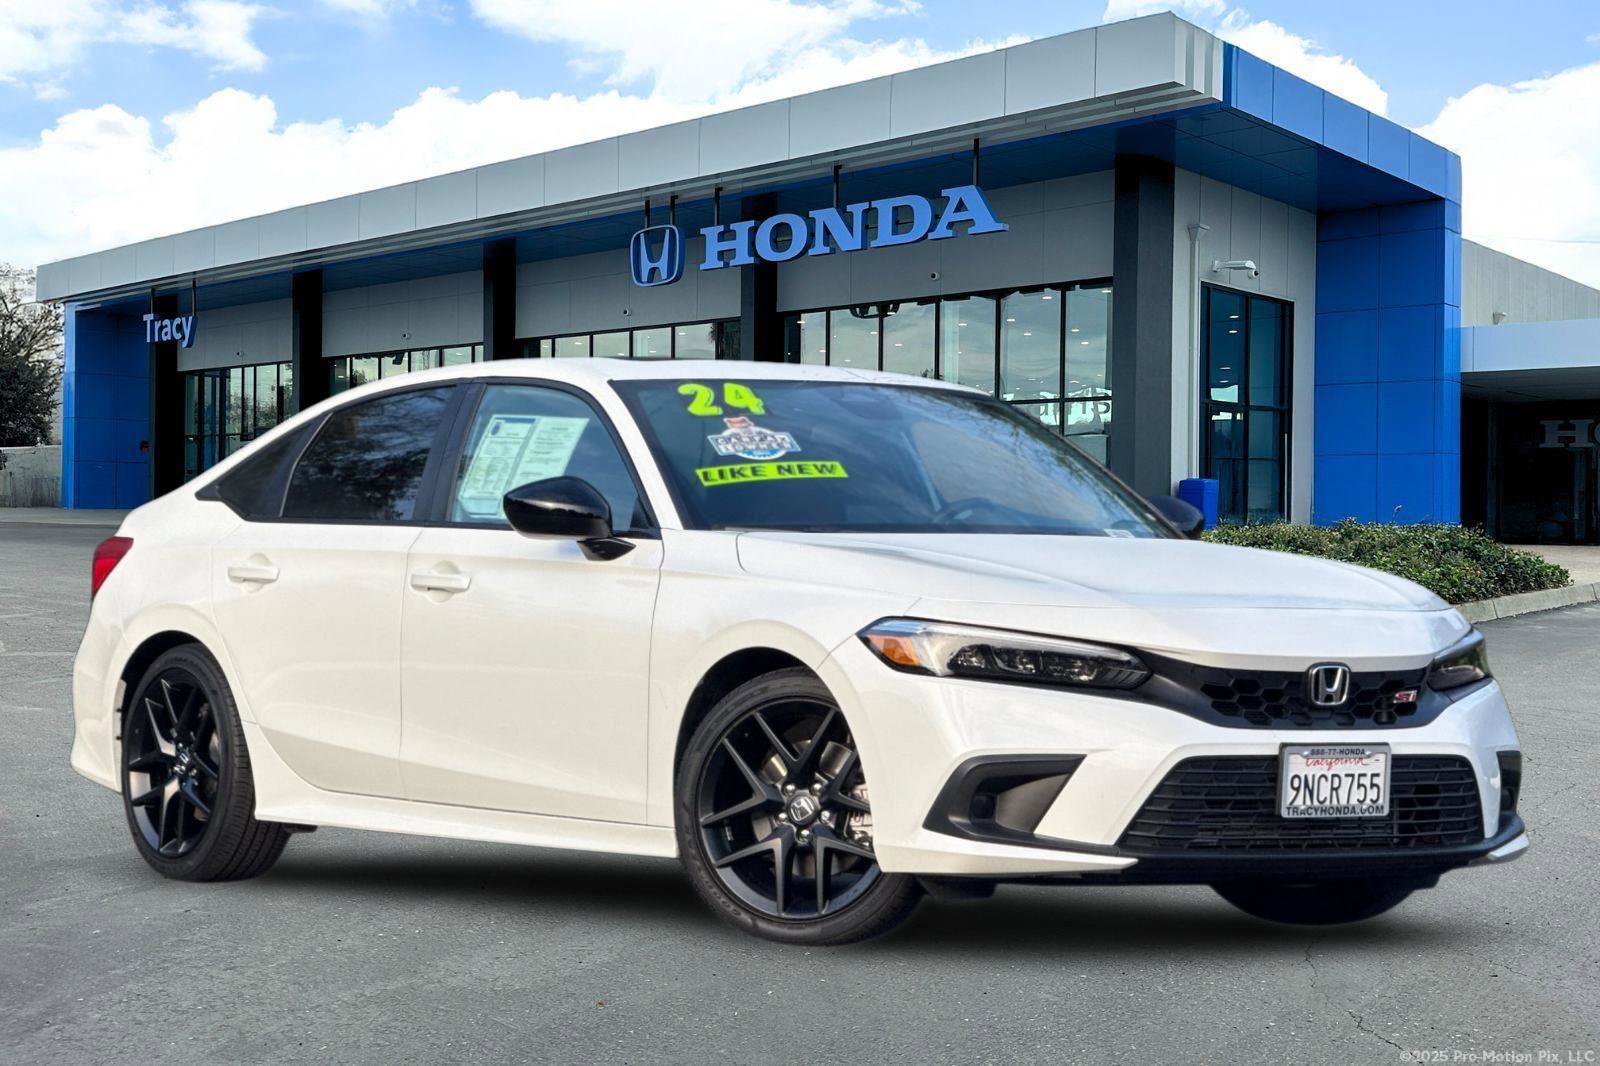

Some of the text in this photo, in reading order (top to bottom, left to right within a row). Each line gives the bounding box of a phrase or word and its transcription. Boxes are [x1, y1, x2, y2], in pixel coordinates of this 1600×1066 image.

[700, 185, 1008, 270] HONDA
[143, 313, 193, 348] Tracy
[677, 382, 765, 416] 24
[701, 463, 836, 482] LIKE NEW
[1290, 773, 1381, 805] 9NCR755
[1286, 805, 1384, 816] TRACYHONDA.COM
